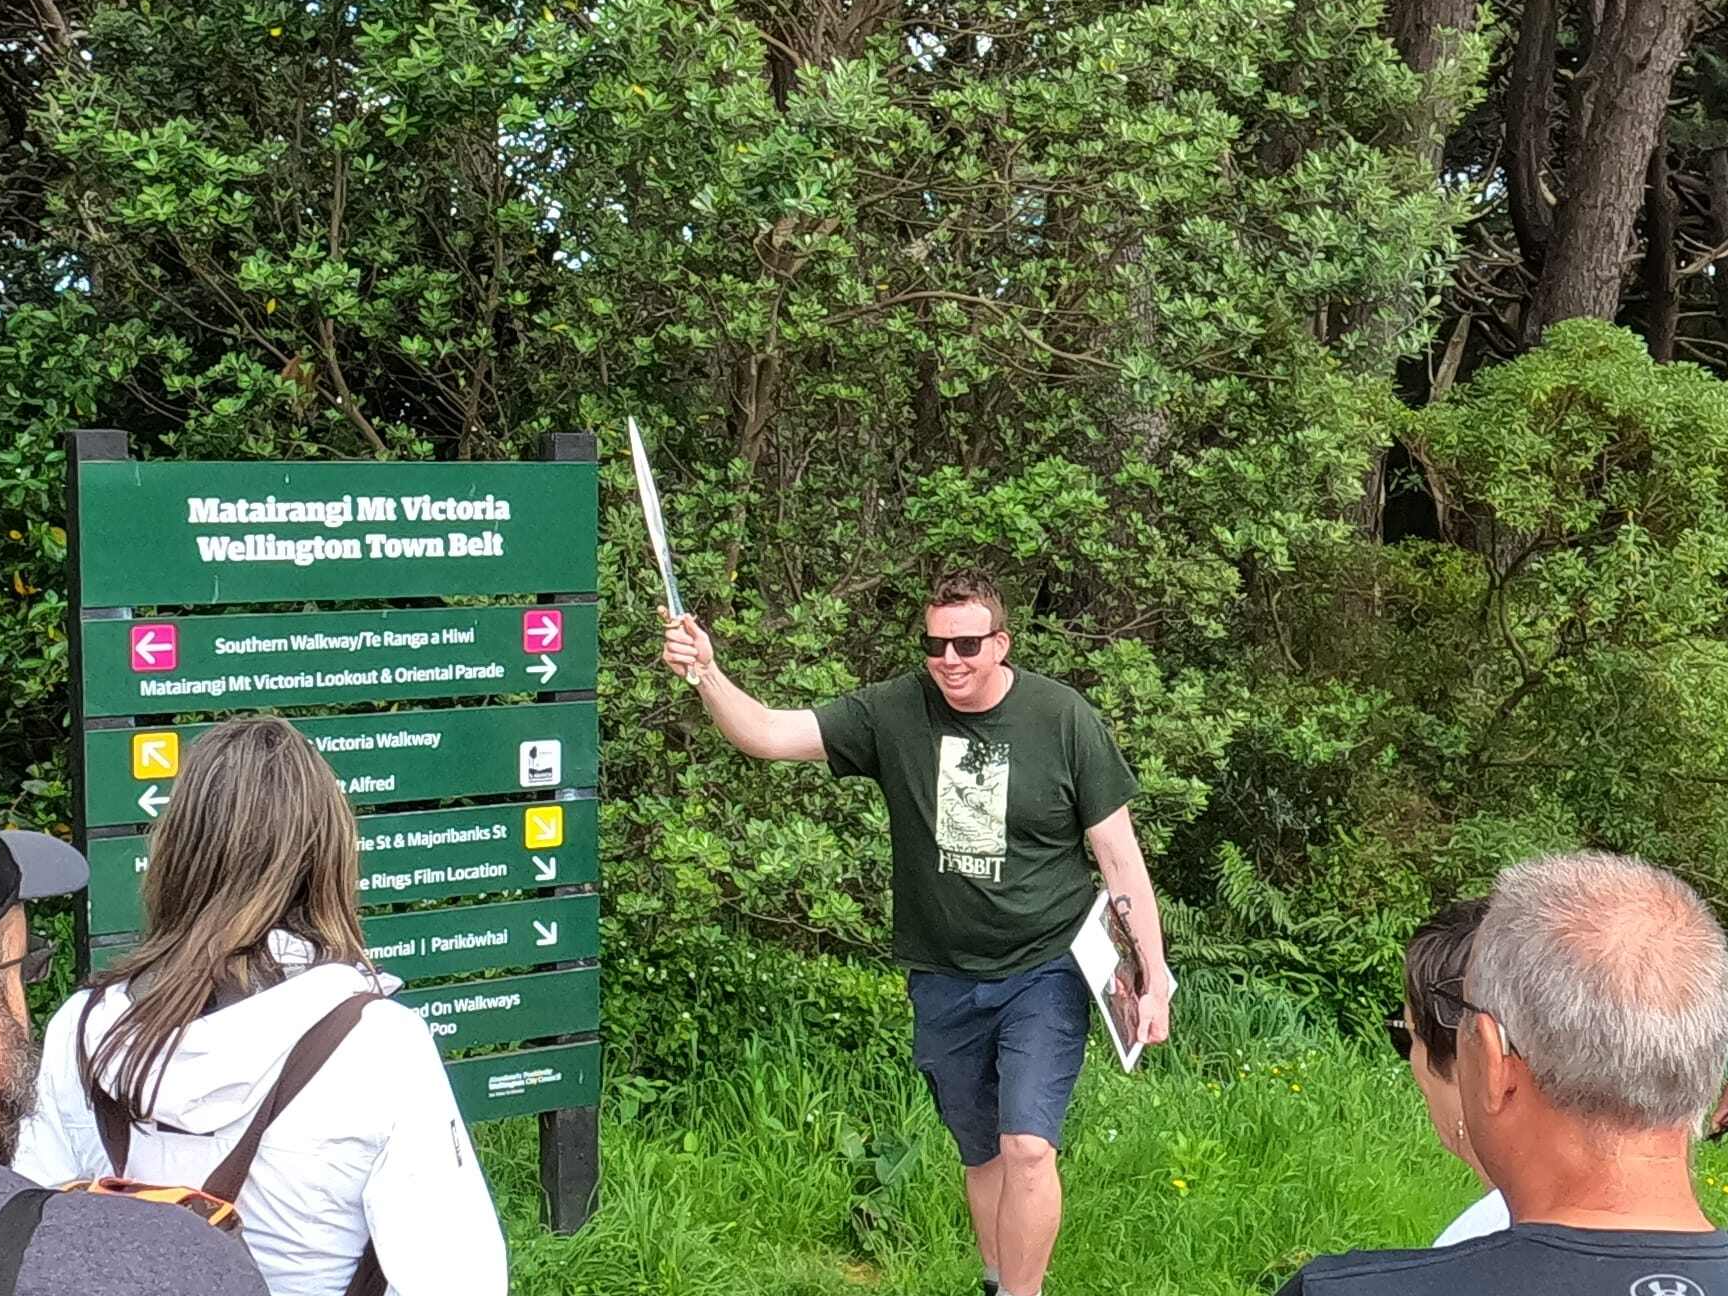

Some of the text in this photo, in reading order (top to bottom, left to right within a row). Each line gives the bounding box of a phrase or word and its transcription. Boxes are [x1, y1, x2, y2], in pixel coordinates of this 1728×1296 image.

[188, 495, 510, 527] Matairangi Mt Victoria
[197, 531, 504, 566] Wellington Town Belt
[215, 635, 288, 654] Southern
[383, 630, 428, 649] Ranga
[430, 632, 440, 644] a
[442, 627, 475, 644] Hiwi
[140, 662, 505, 696] Matairangi Mt Victoria Lookout & Oriental Parade
[315, 730, 442, 751] Victoria Walkway
[348, 775, 395, 793] Alfred
[376, 834, 391, 850] St
[393, 833, 405, 848] &
[407, 827, 490, 849] Majoribanks
[492, 824, 507, 840] St
[371, 872, 412, 890] Rings
[413, 866, 445, 885] Film
[447, 863, 507, 882] Location
[362, 938, 415, 960] emorial
[431, 1000, 452, 1017] On
[453, 993, 520, 1013] Walkways
